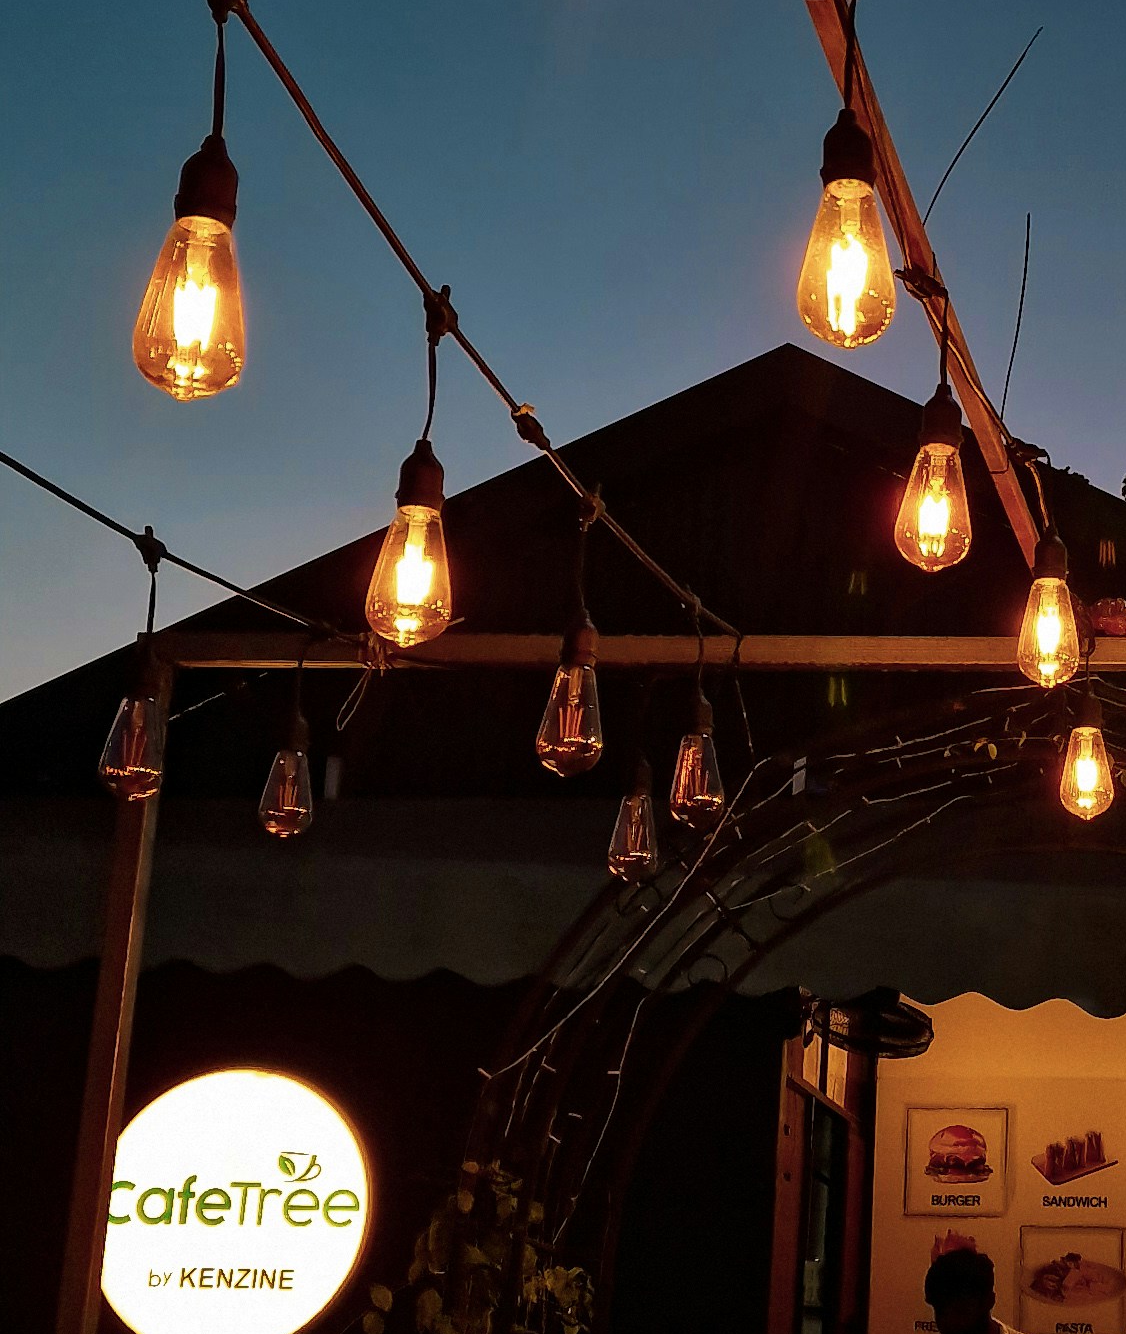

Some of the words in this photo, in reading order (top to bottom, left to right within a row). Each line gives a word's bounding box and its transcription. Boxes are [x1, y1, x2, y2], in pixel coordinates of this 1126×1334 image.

[931, 1194, 981, 1207] BURGER
[1042, 1195, 1108, 1208] SANDWICH
[148, 1269, 173, 1288] by
[179, 1267, 296, 1290] KENZINE
[1055, 1322, 1094, 1334] PASTA
